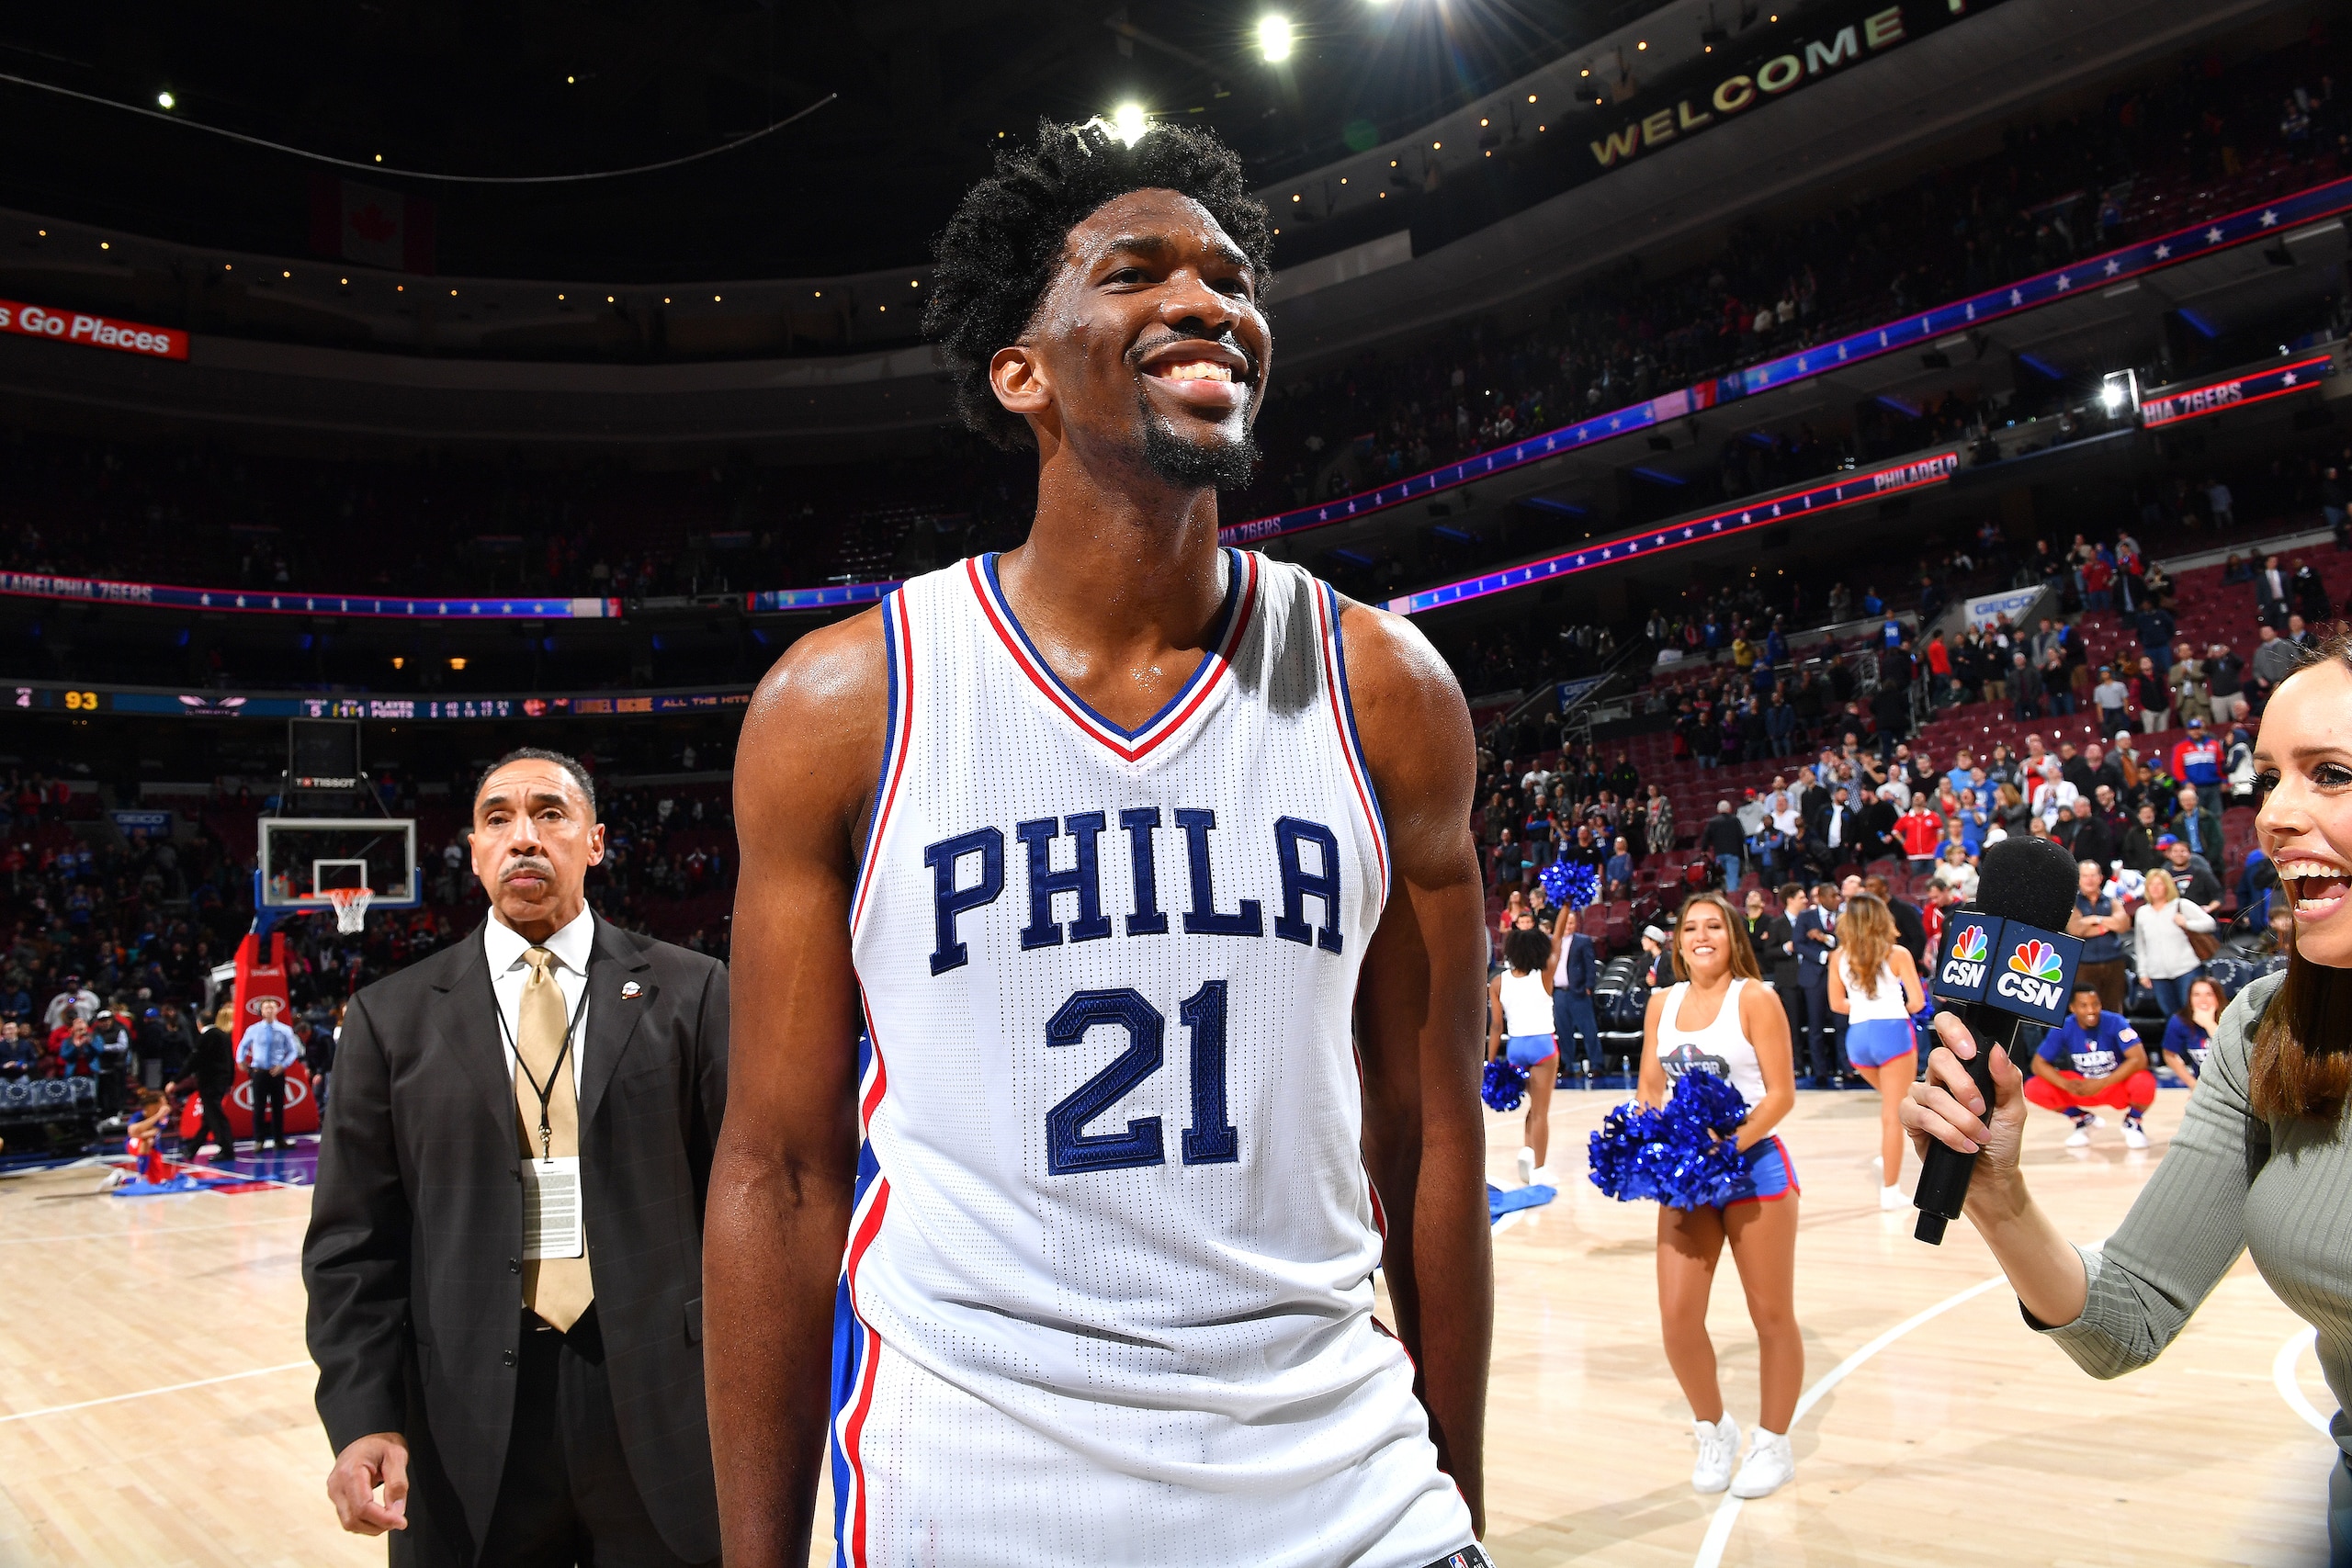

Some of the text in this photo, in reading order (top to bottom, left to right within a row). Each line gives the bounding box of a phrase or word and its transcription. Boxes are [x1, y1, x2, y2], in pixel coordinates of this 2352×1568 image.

[1590, 6, 1905, 167] WELCOME
[19, 307, 64, 335] Go
[70, 315, 170, 354] Places
[2178, 382, 2242, 413] 76ERS
[1240, 516, 1281, 540] 76ERS
[98, 582, 153, 603] 76ERS
[64, 691, 98, 710] 93
[662, 699, 687, 707] ALL
[692, 697, 717, 706] THE
[721, 695, 749, 705] HITS
[924, 807, 1343, 976] PHILA
[1942, 960, 1986, 988] CSN
[1996, 972, 2064, 1010] CSN
[1046, 980, 1238, 1176] 21
